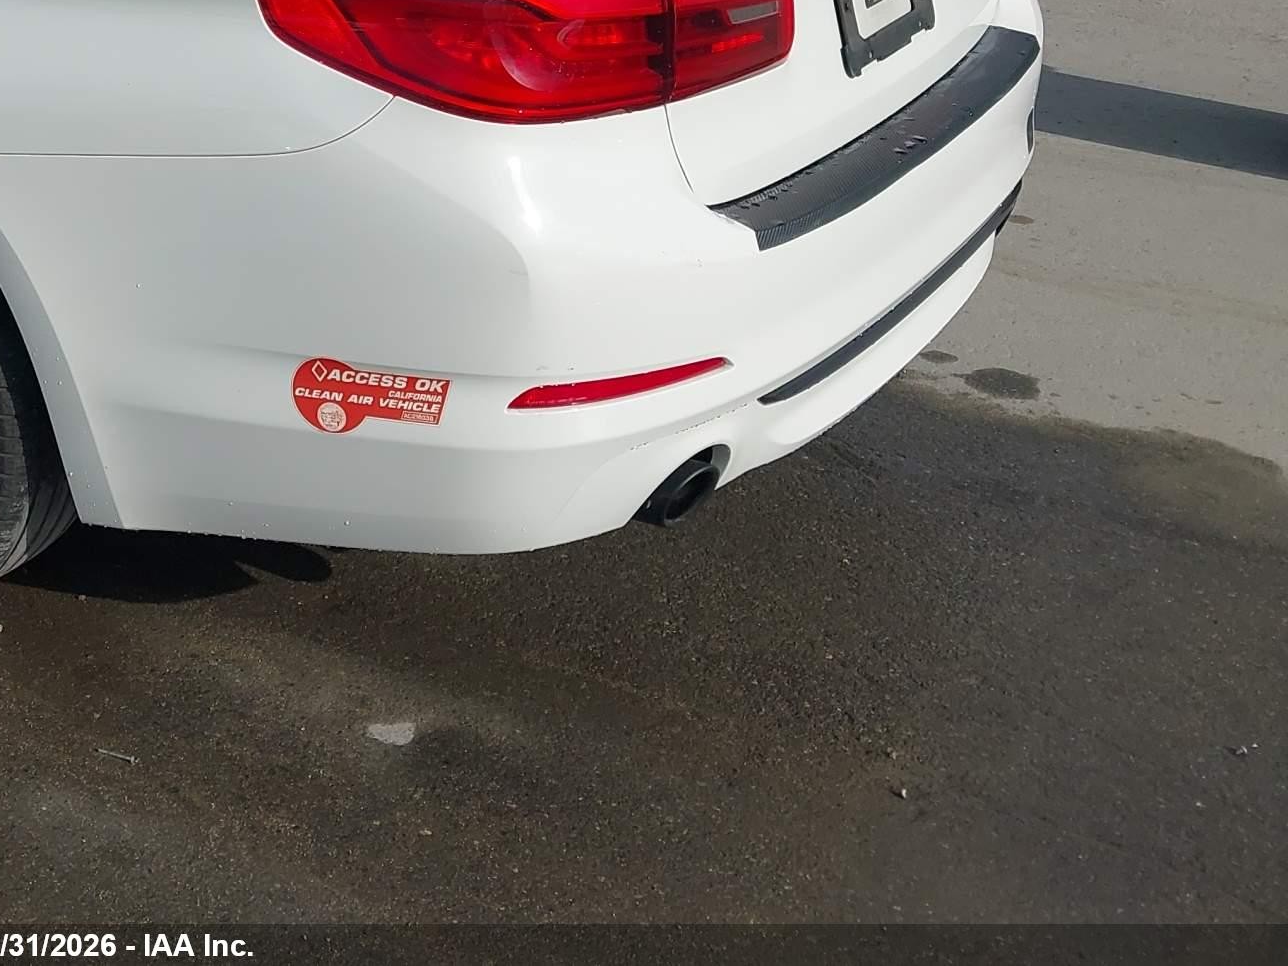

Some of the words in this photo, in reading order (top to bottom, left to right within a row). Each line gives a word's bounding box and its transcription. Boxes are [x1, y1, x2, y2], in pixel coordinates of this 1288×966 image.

[327, 368, 408, 389] ACCESS
[415, 379, 447, 393] OK
[295, 387, 343, 402] CLEAN
[347, 394, 373, 405] AIR
[379, 398, 442, 413] VEHICLE
[388, 390, 443, 403] CALIFORNIA
